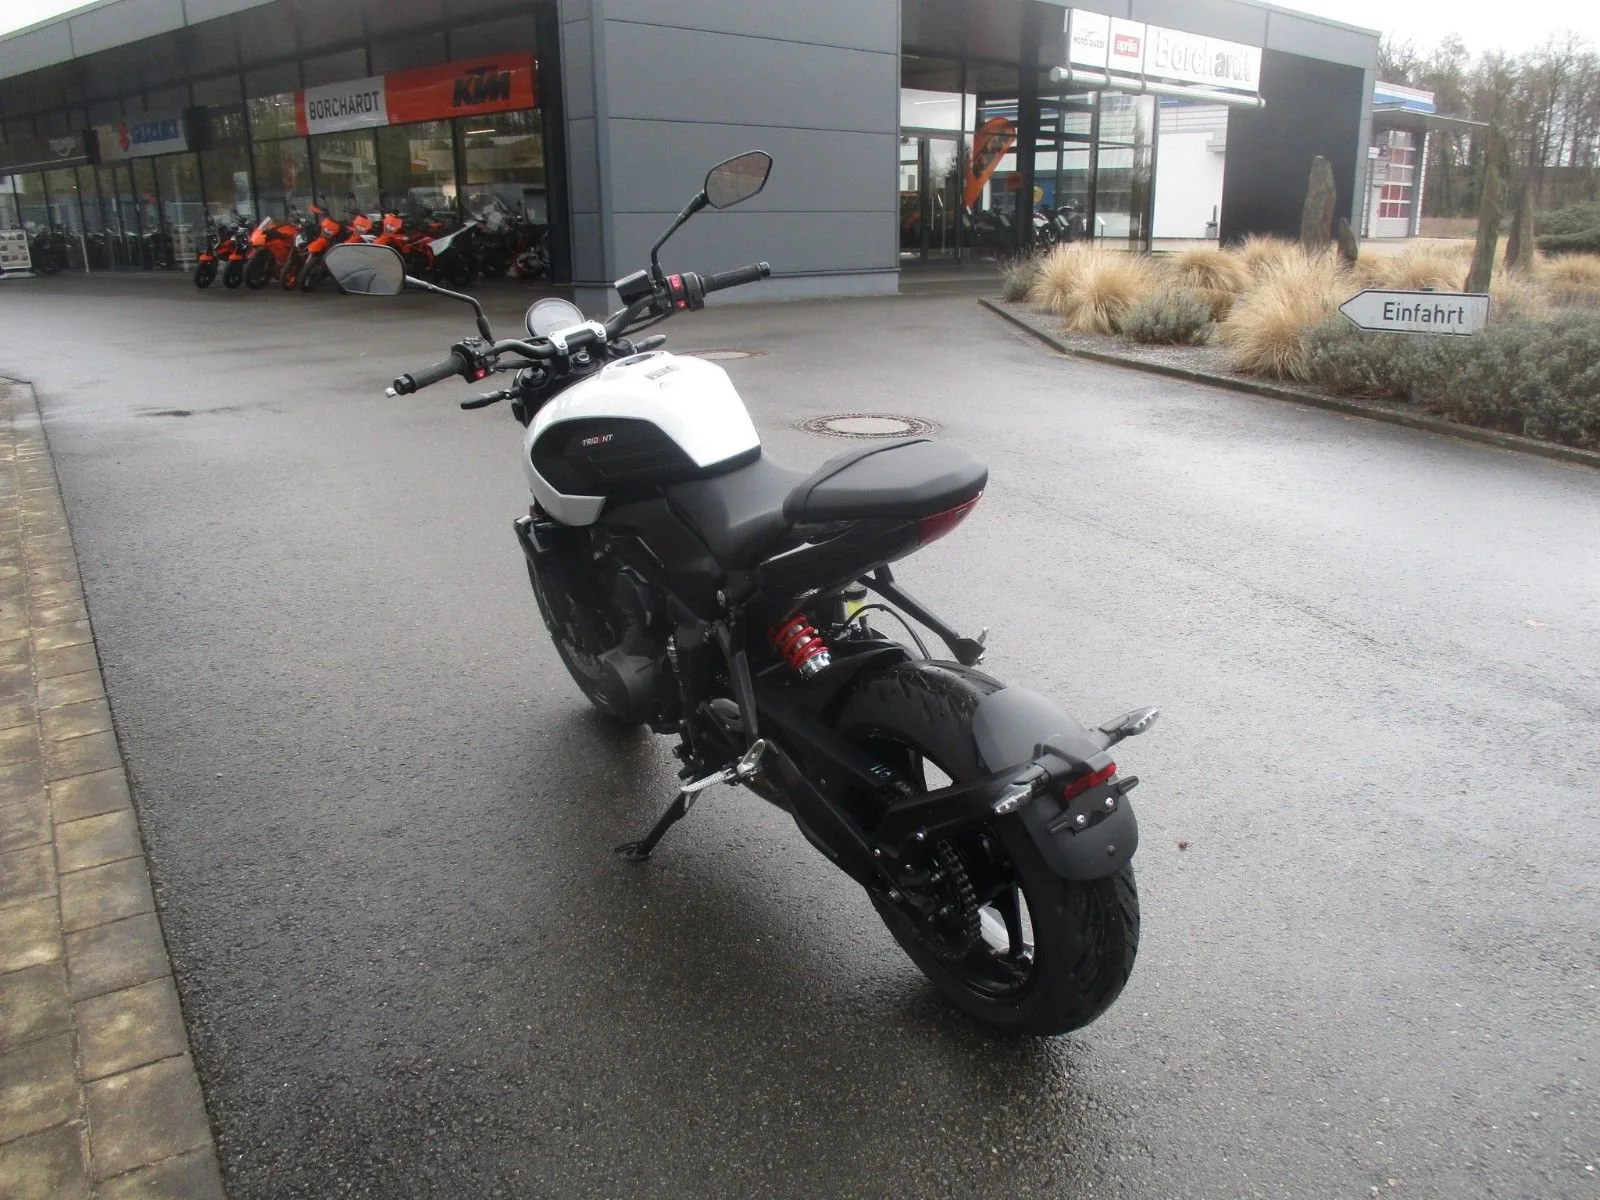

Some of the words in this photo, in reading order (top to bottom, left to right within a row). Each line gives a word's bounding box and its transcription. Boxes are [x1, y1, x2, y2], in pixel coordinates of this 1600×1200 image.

[1154, 28, 1254, 83] Borchardt
[451, 65, 512, 107] KTM
[308, 90, 381, 121] BORCHARDT
[1382, 301, 1465, 325] Einfahrt
[582, 432, 614, 447] TRIDENT
